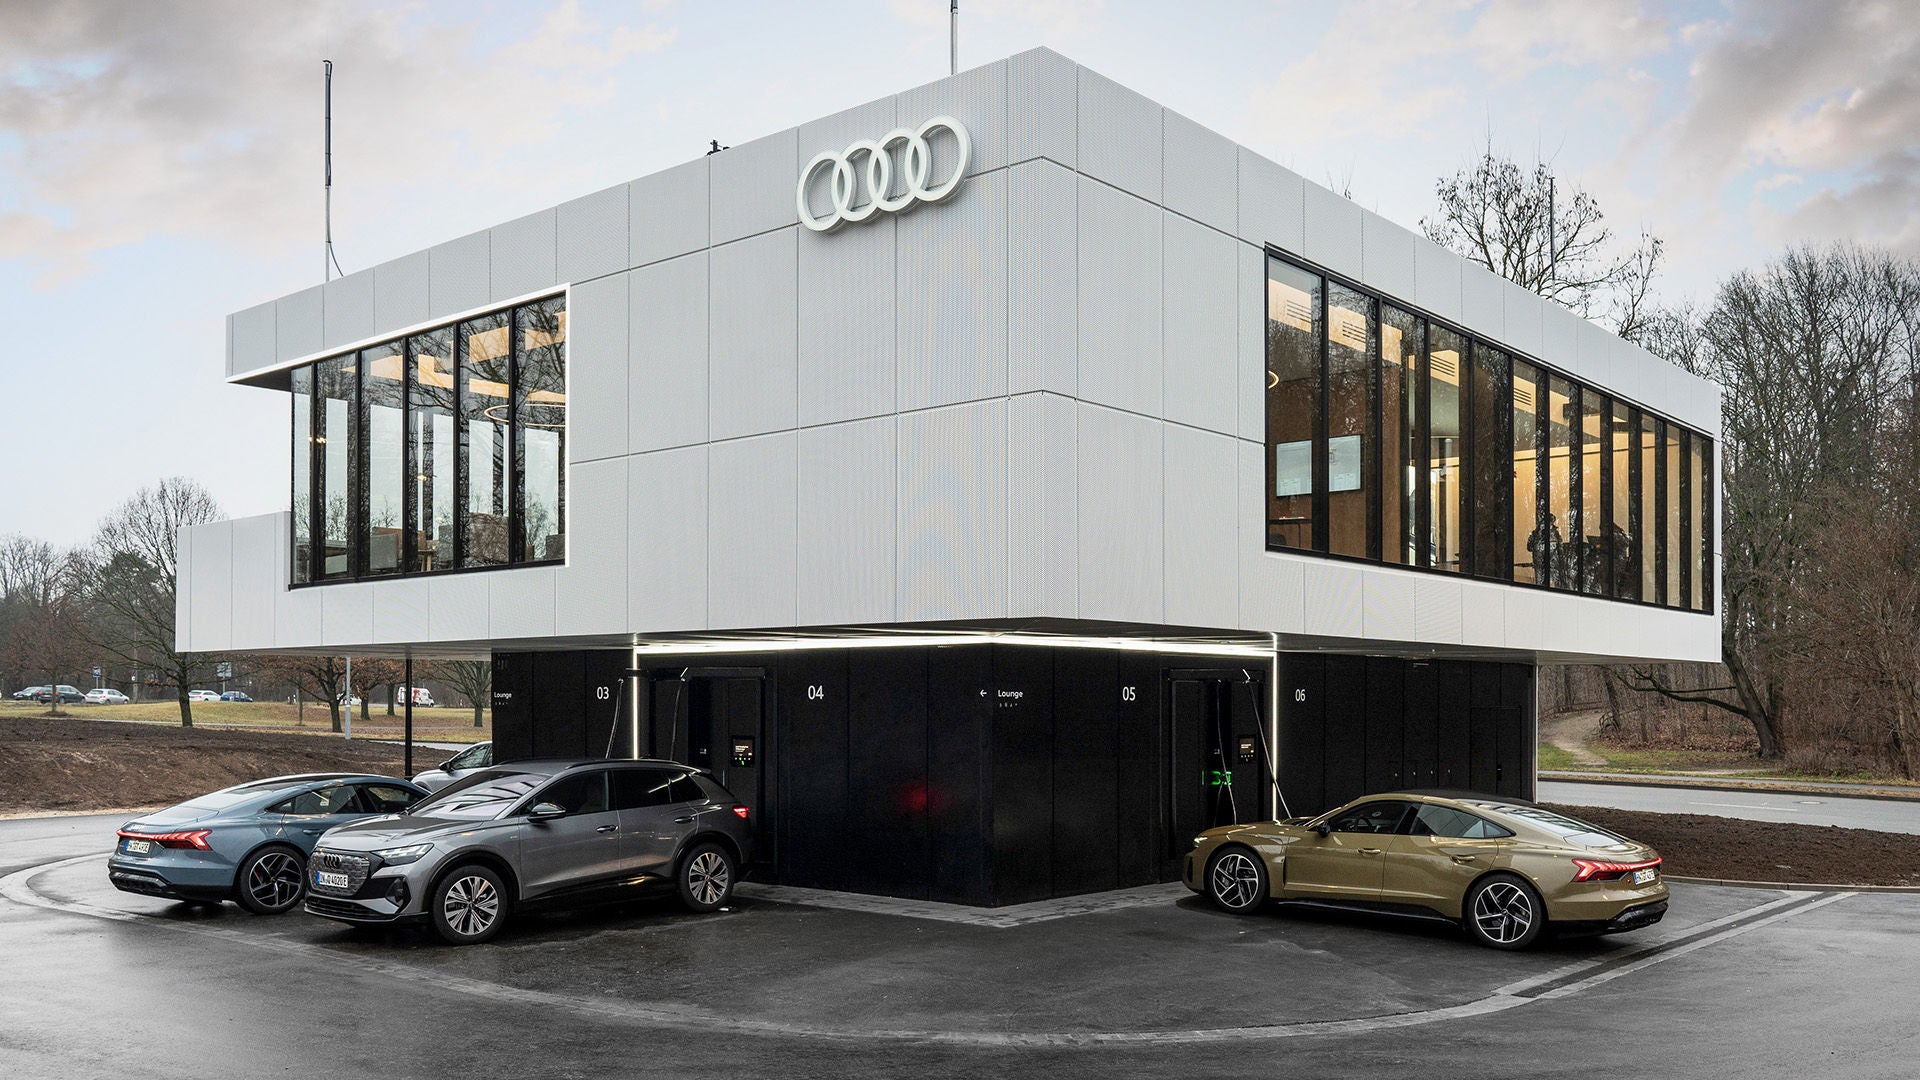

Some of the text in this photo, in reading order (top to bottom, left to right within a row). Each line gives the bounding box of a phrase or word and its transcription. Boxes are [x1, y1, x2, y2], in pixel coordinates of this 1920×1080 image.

[596, 686, 610, 700] 03
[807, 685, 825, 700] 04
[997, 689, 1024, 700] Lounge
[1122, 686, 1136, 701] 05
[1295, 688, 1306, 702] 06
